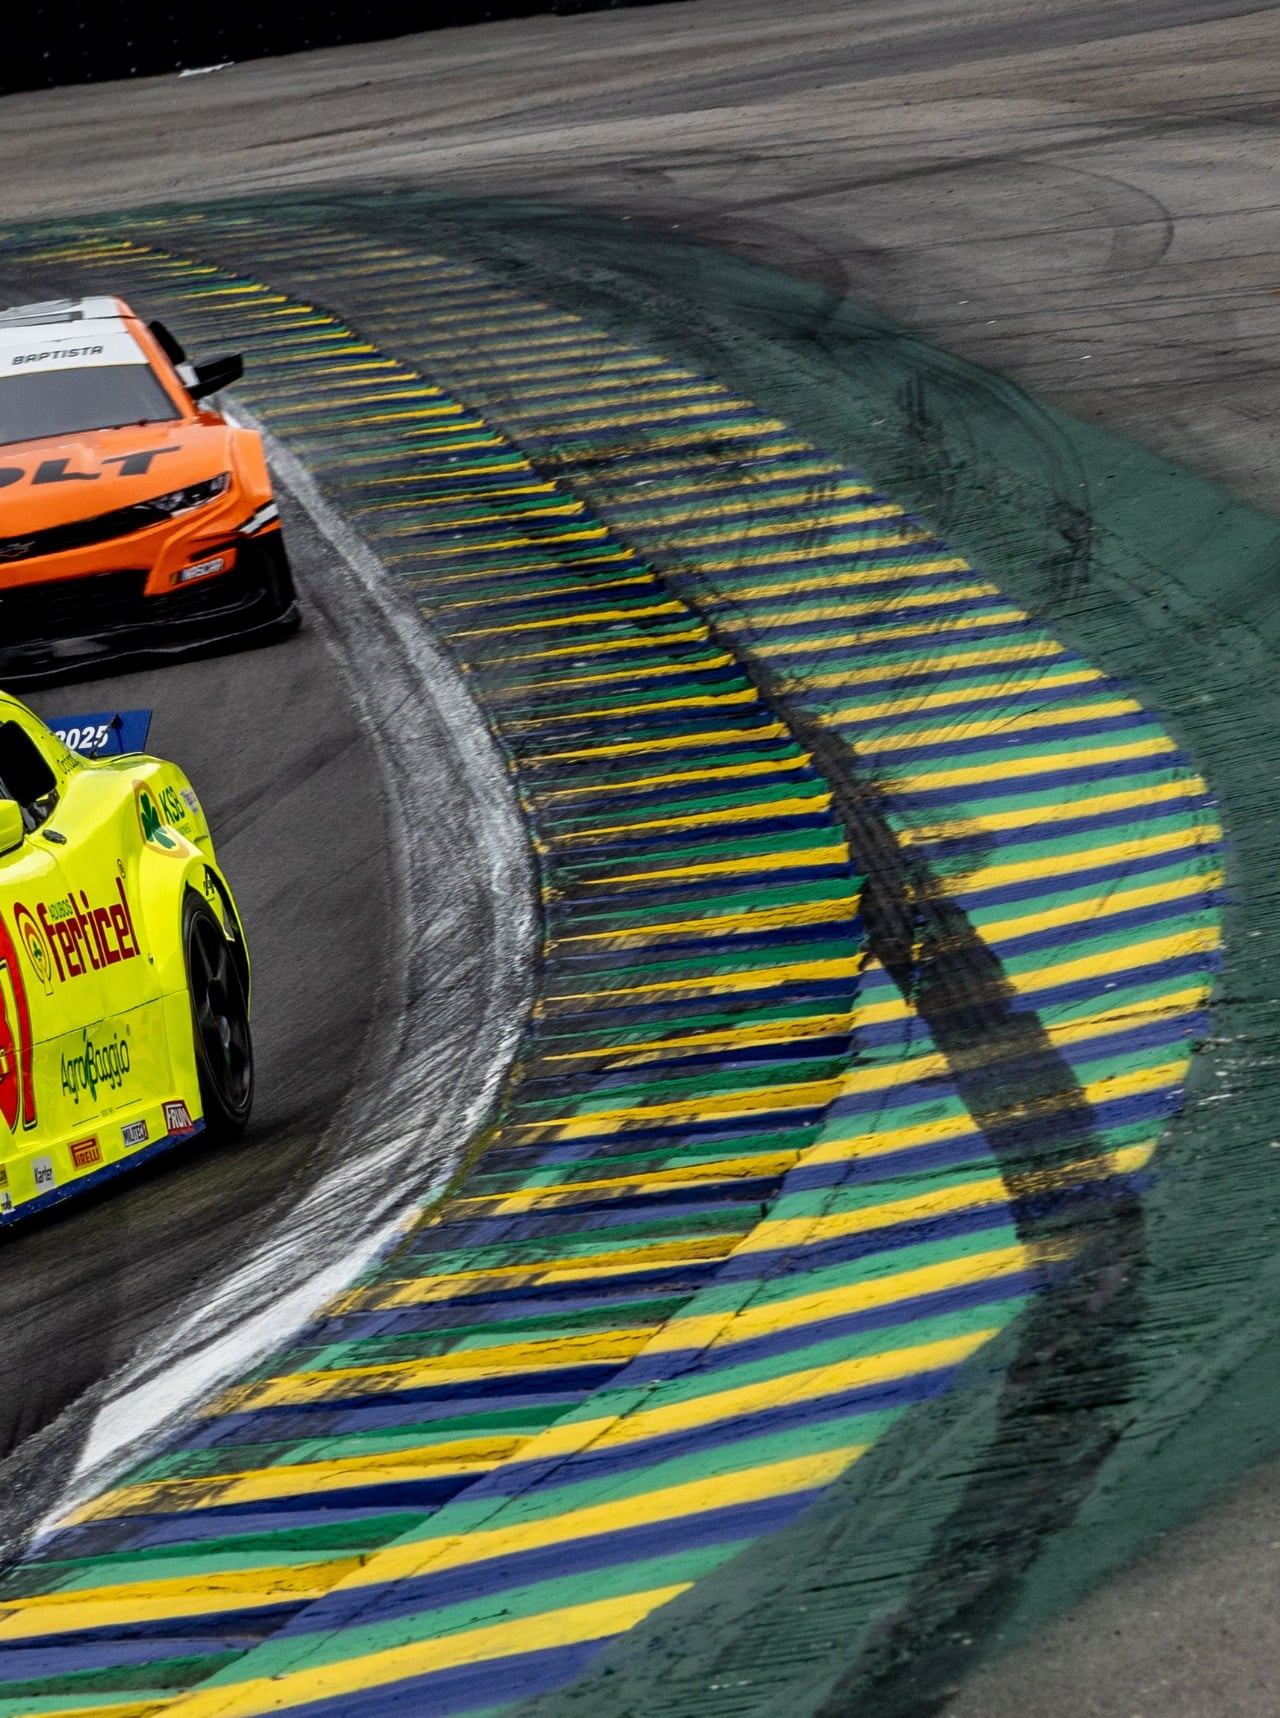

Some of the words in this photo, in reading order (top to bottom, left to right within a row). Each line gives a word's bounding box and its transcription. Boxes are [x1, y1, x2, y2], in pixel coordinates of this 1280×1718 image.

[12, 345, 104, 366] BAPTISTA
[179, 558, 225, 581] NASCAR
[159, 786, 185, 825] KSB
[36, 877, 140, 983] ferticel
[71, 1138, 100, 1168] PIRELLI
